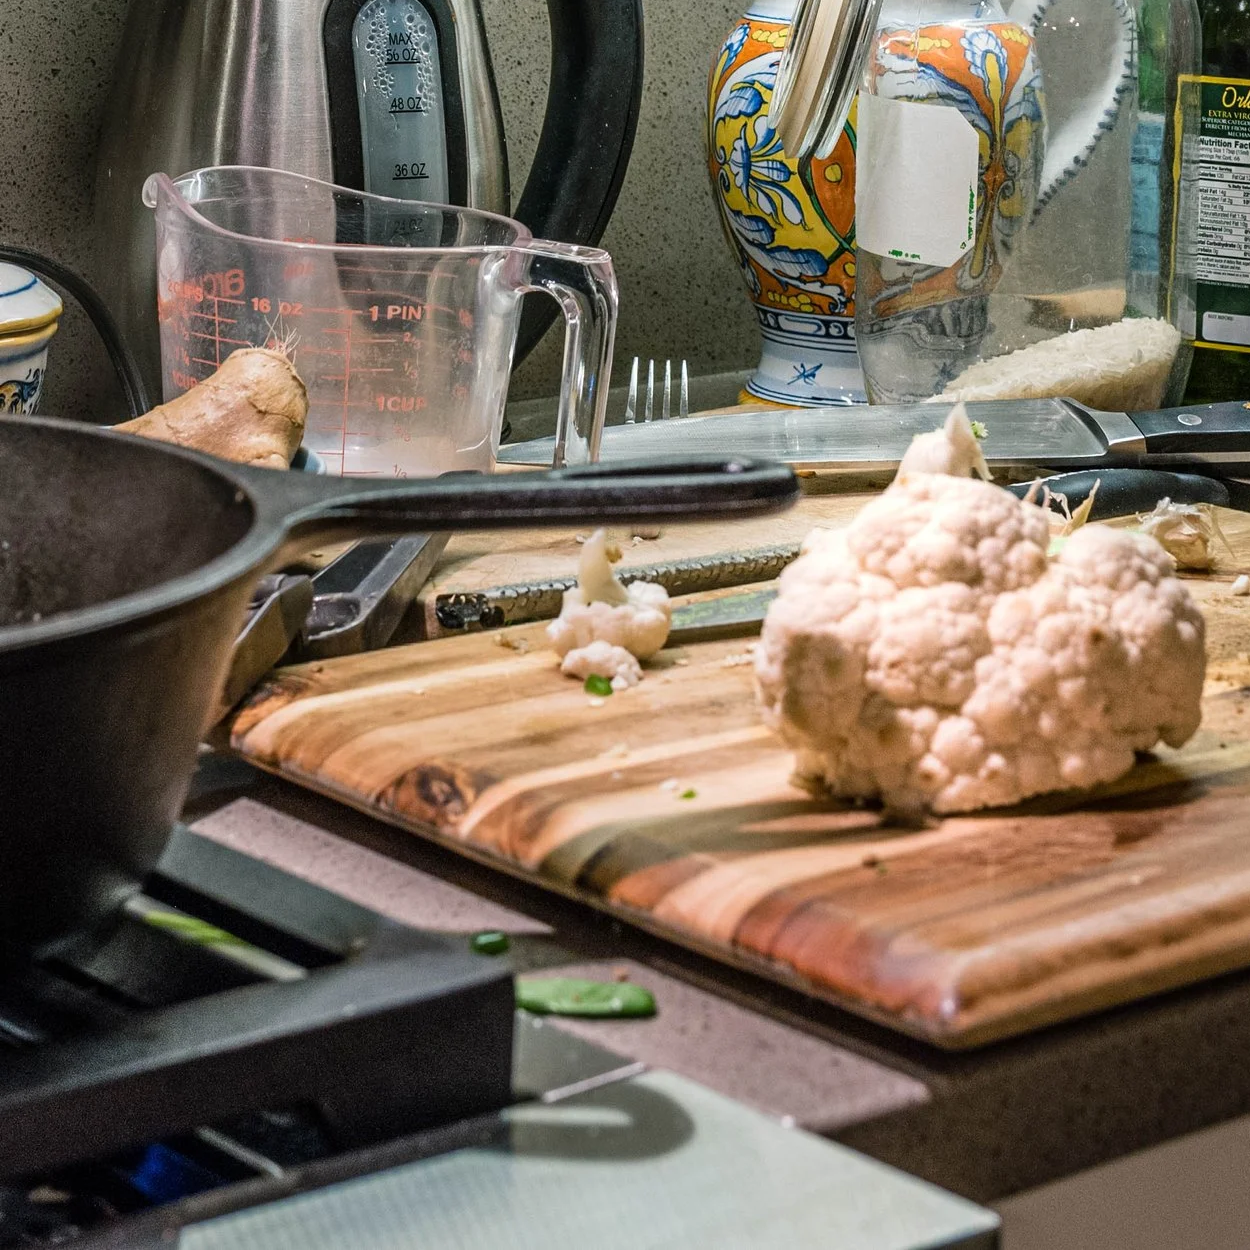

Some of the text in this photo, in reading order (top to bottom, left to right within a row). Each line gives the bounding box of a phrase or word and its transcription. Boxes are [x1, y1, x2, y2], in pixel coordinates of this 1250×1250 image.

[388, 32, 413, 46] MAX
[386, 48, 418, 62] 56 OZ
[391, 96, 422, 110] 48 OZ
[1208, 110, 1232, 118] EXTRA
[1199, 137, 1232, 148] Nutrition
[395, 163, 427, 177] 36 OZ
[251, 297, 304, 316] 16 OZ
[368, 305, 432, 321] 1 PINT
